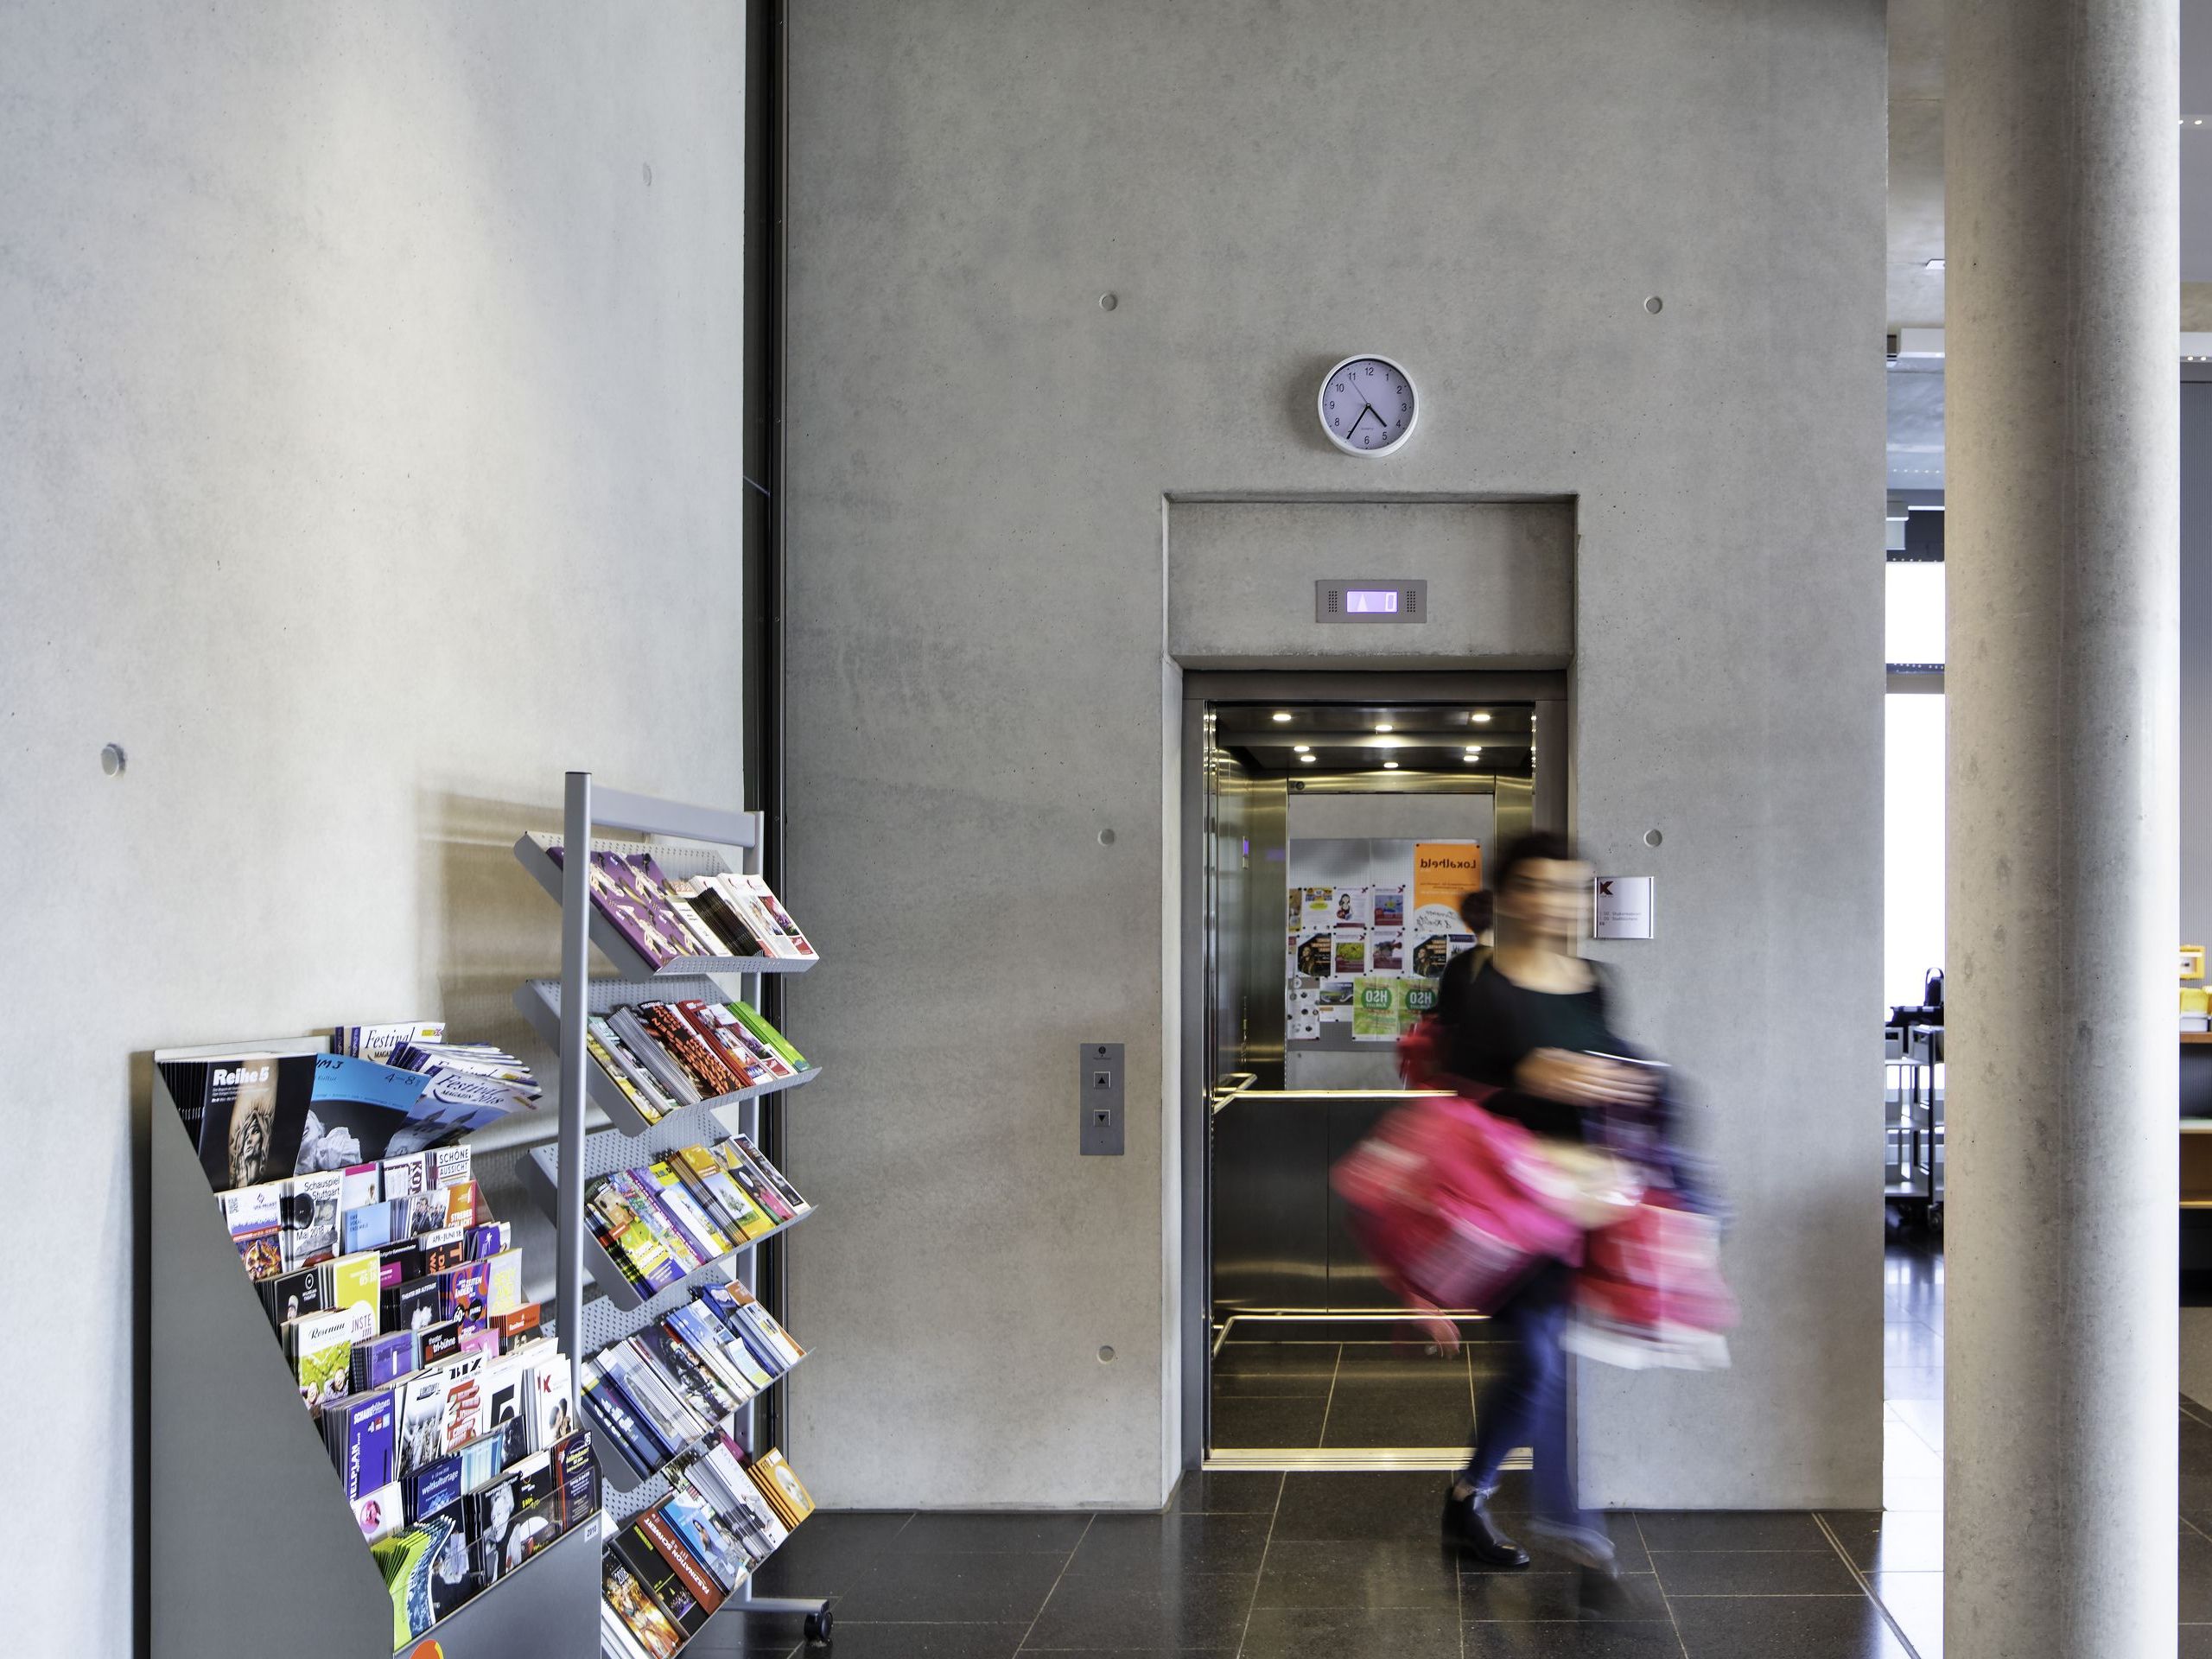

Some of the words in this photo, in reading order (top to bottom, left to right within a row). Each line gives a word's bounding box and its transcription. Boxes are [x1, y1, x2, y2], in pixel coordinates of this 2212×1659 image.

[365, 1027, 415, 1049] Festival
[436, 1074, 511, 1095] Festival
[439, 1148, 469, 1164] SCHÖNE
[440, 1163, 467, 1176] AUSSICHT
[304, 1176, 340, 1192] Schauspiel
[312, 1188, 340, 1201] Stuttgart
[296, 1230, 308, 1241] Mai
[309, 1225, 325, 1238] 2018
[543, 1375, 551, 1393] K
